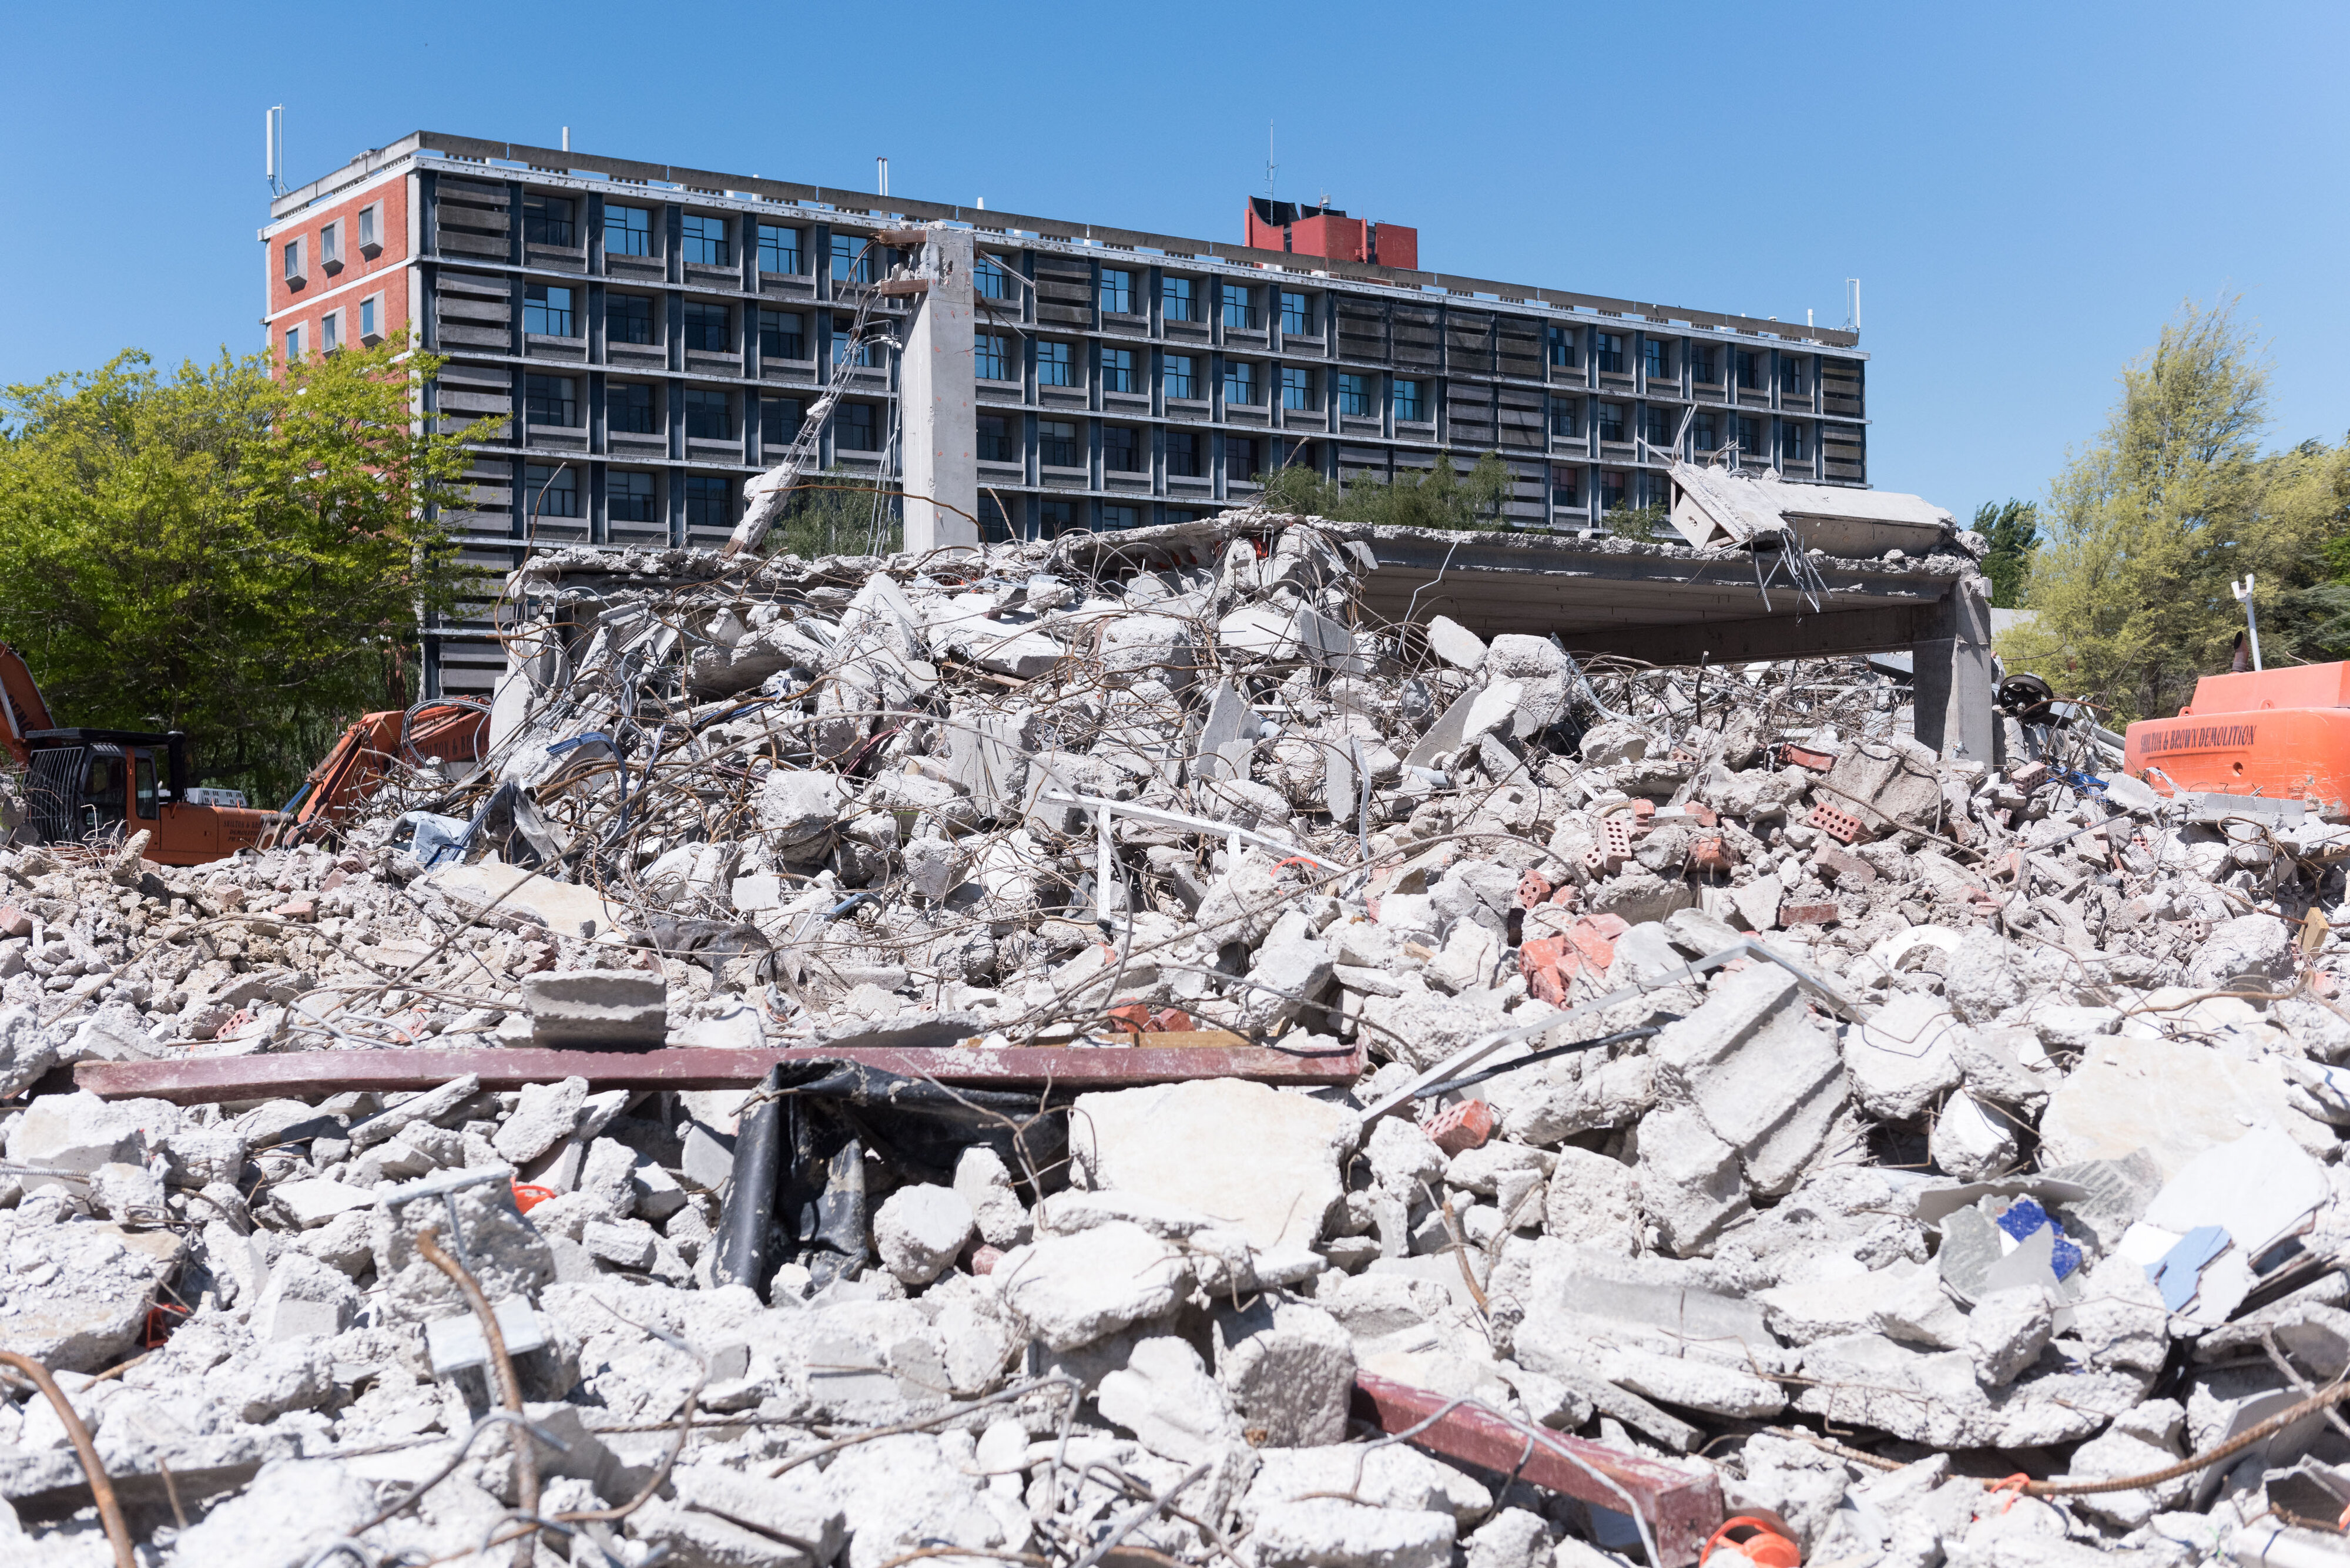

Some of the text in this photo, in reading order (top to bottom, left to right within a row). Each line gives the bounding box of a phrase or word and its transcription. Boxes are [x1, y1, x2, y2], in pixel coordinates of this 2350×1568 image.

[2140, 725, 2257, 754] SHILTON & BROWN DEMOLITION
[223, 820, 244, 828] SHILTON
